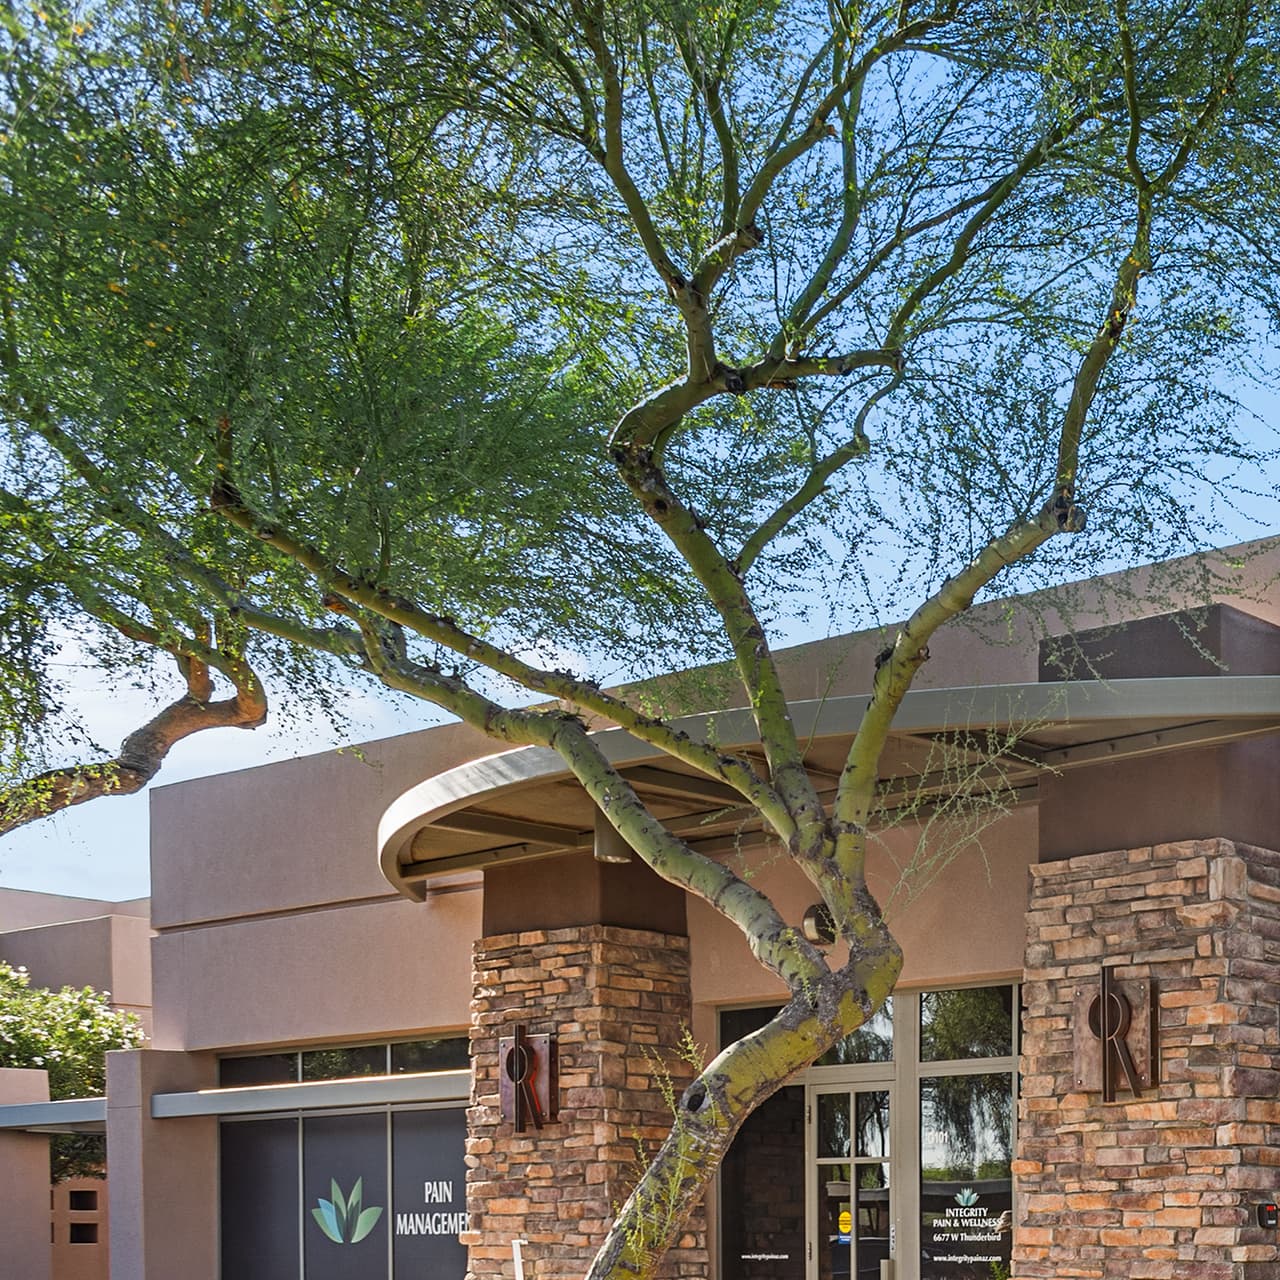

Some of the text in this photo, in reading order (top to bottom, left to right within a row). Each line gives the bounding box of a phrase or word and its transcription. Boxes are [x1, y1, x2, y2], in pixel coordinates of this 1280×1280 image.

[424, 1180, 453, 1204] PAIN
[945, 1207, 989, 1218] INTEGRITY
[933, 1218, 1002, 1228] PAIN & WELLNESS
[933, 1232, 1002, 1242] 6677 W Thunderbird
[933, 1254, 1002, 1264] www.integritypainaz.com
